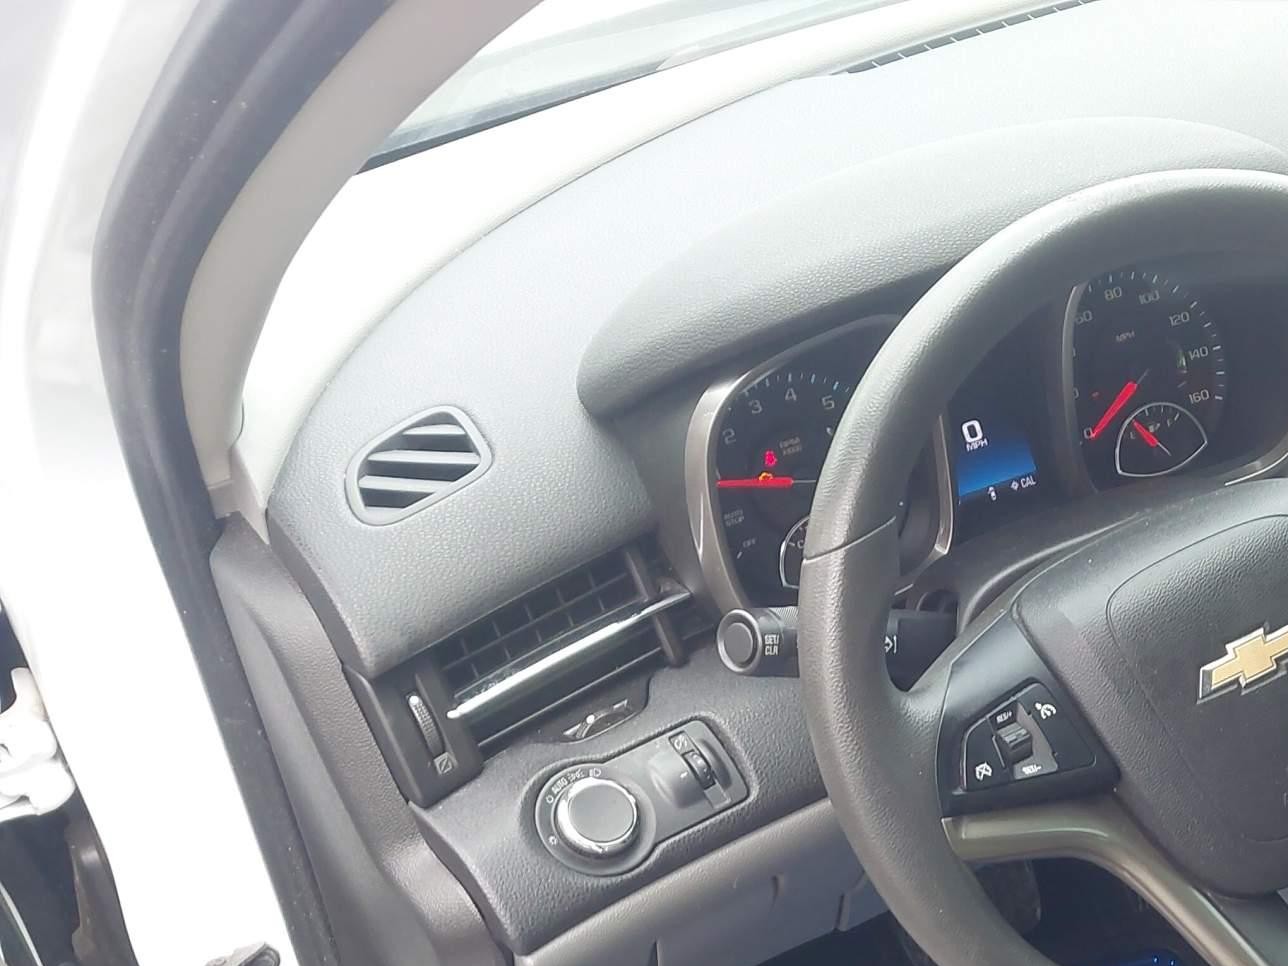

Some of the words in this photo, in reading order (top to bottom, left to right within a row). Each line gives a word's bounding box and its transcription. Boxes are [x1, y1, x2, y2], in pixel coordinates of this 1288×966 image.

[1104, 286, 1122, 300] 80
[1169, 311, 1190, 326] 120
[1189, 346, 1209, 361] 140
[785, 388, 797, 401] 4
[1189, 389, 1210, 404] 160
[751, 400, 763, 414] 3
[822, 395, 835, 410] 5
[723, 428, 736, 444] 2
[962, 420, 983, 443] 0
[966, 438, 988, 451] MPH
[1021, 475, 1036, 488] CAL
[551, 778, 568, 794] AUTO
